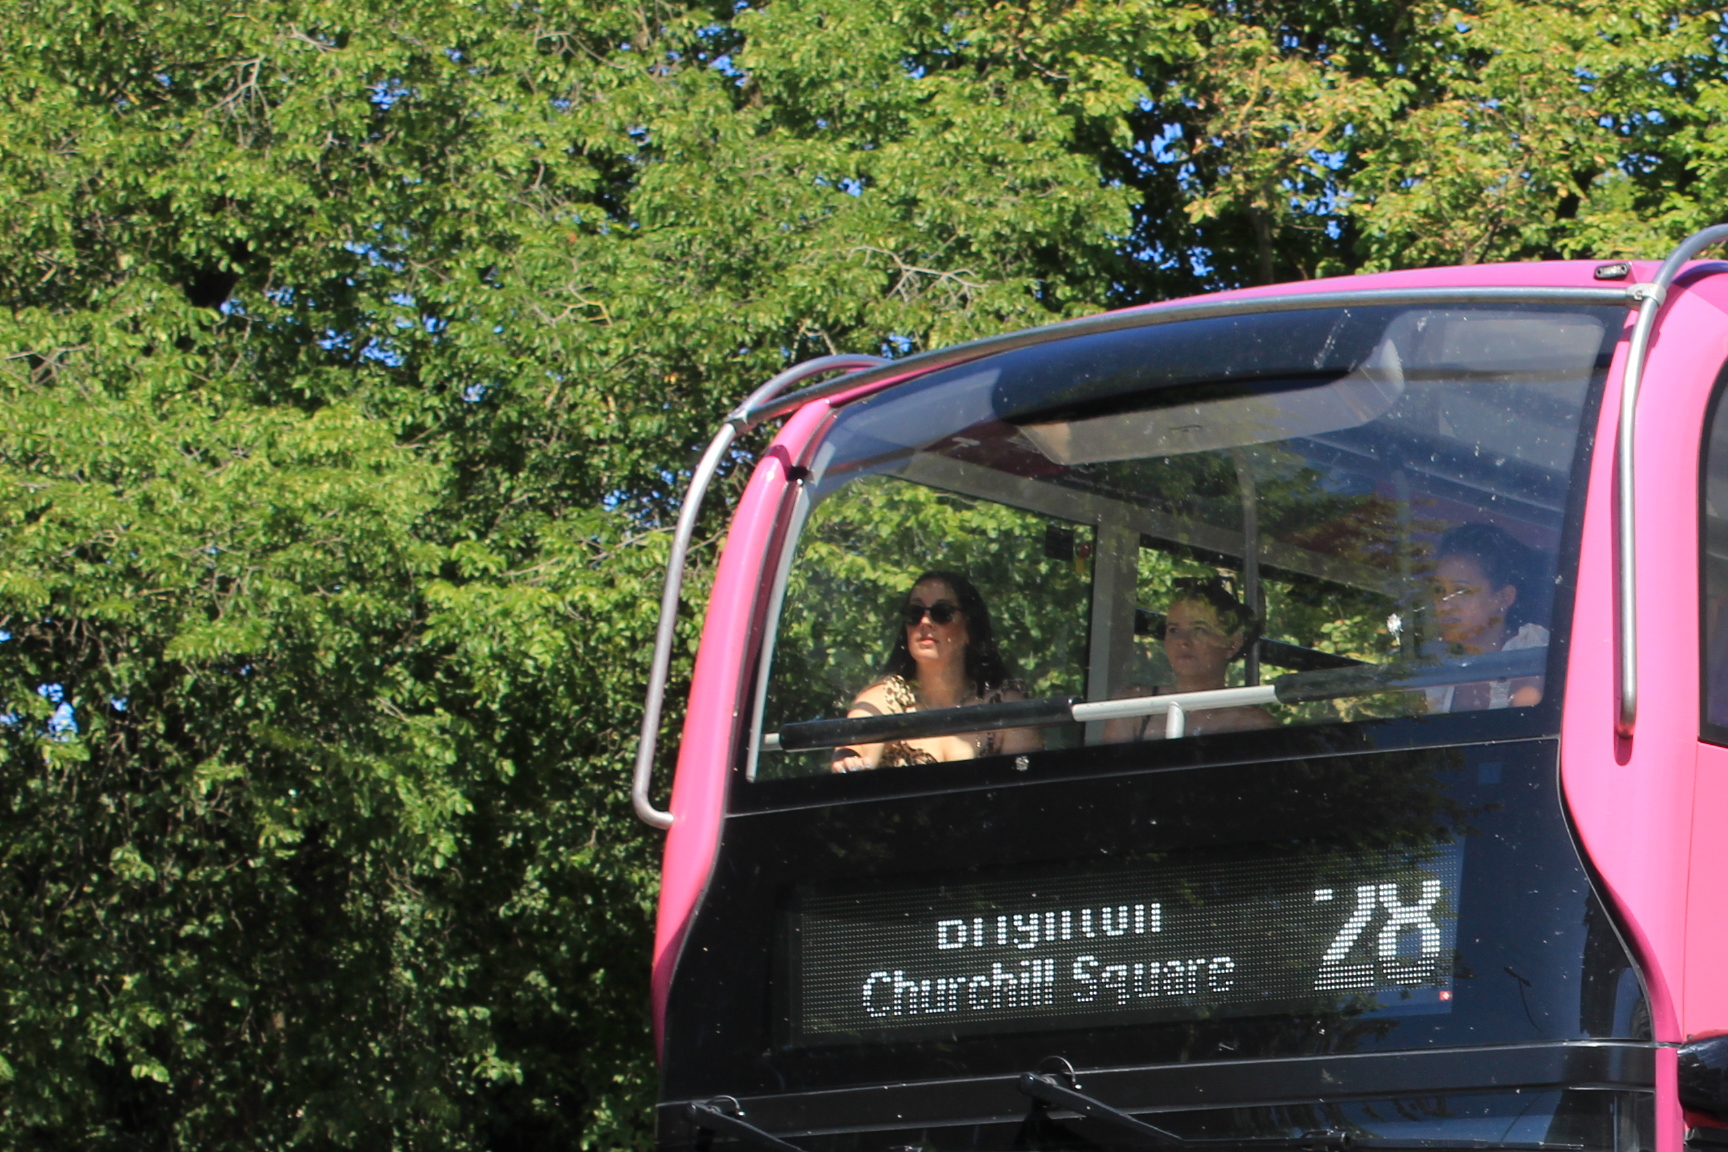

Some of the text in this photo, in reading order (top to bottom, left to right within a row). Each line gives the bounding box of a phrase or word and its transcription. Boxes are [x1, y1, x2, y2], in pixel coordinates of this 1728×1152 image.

[1314, 880, 1441, 990] 28
[863, 955, 1236, 1018] Churchill Square
